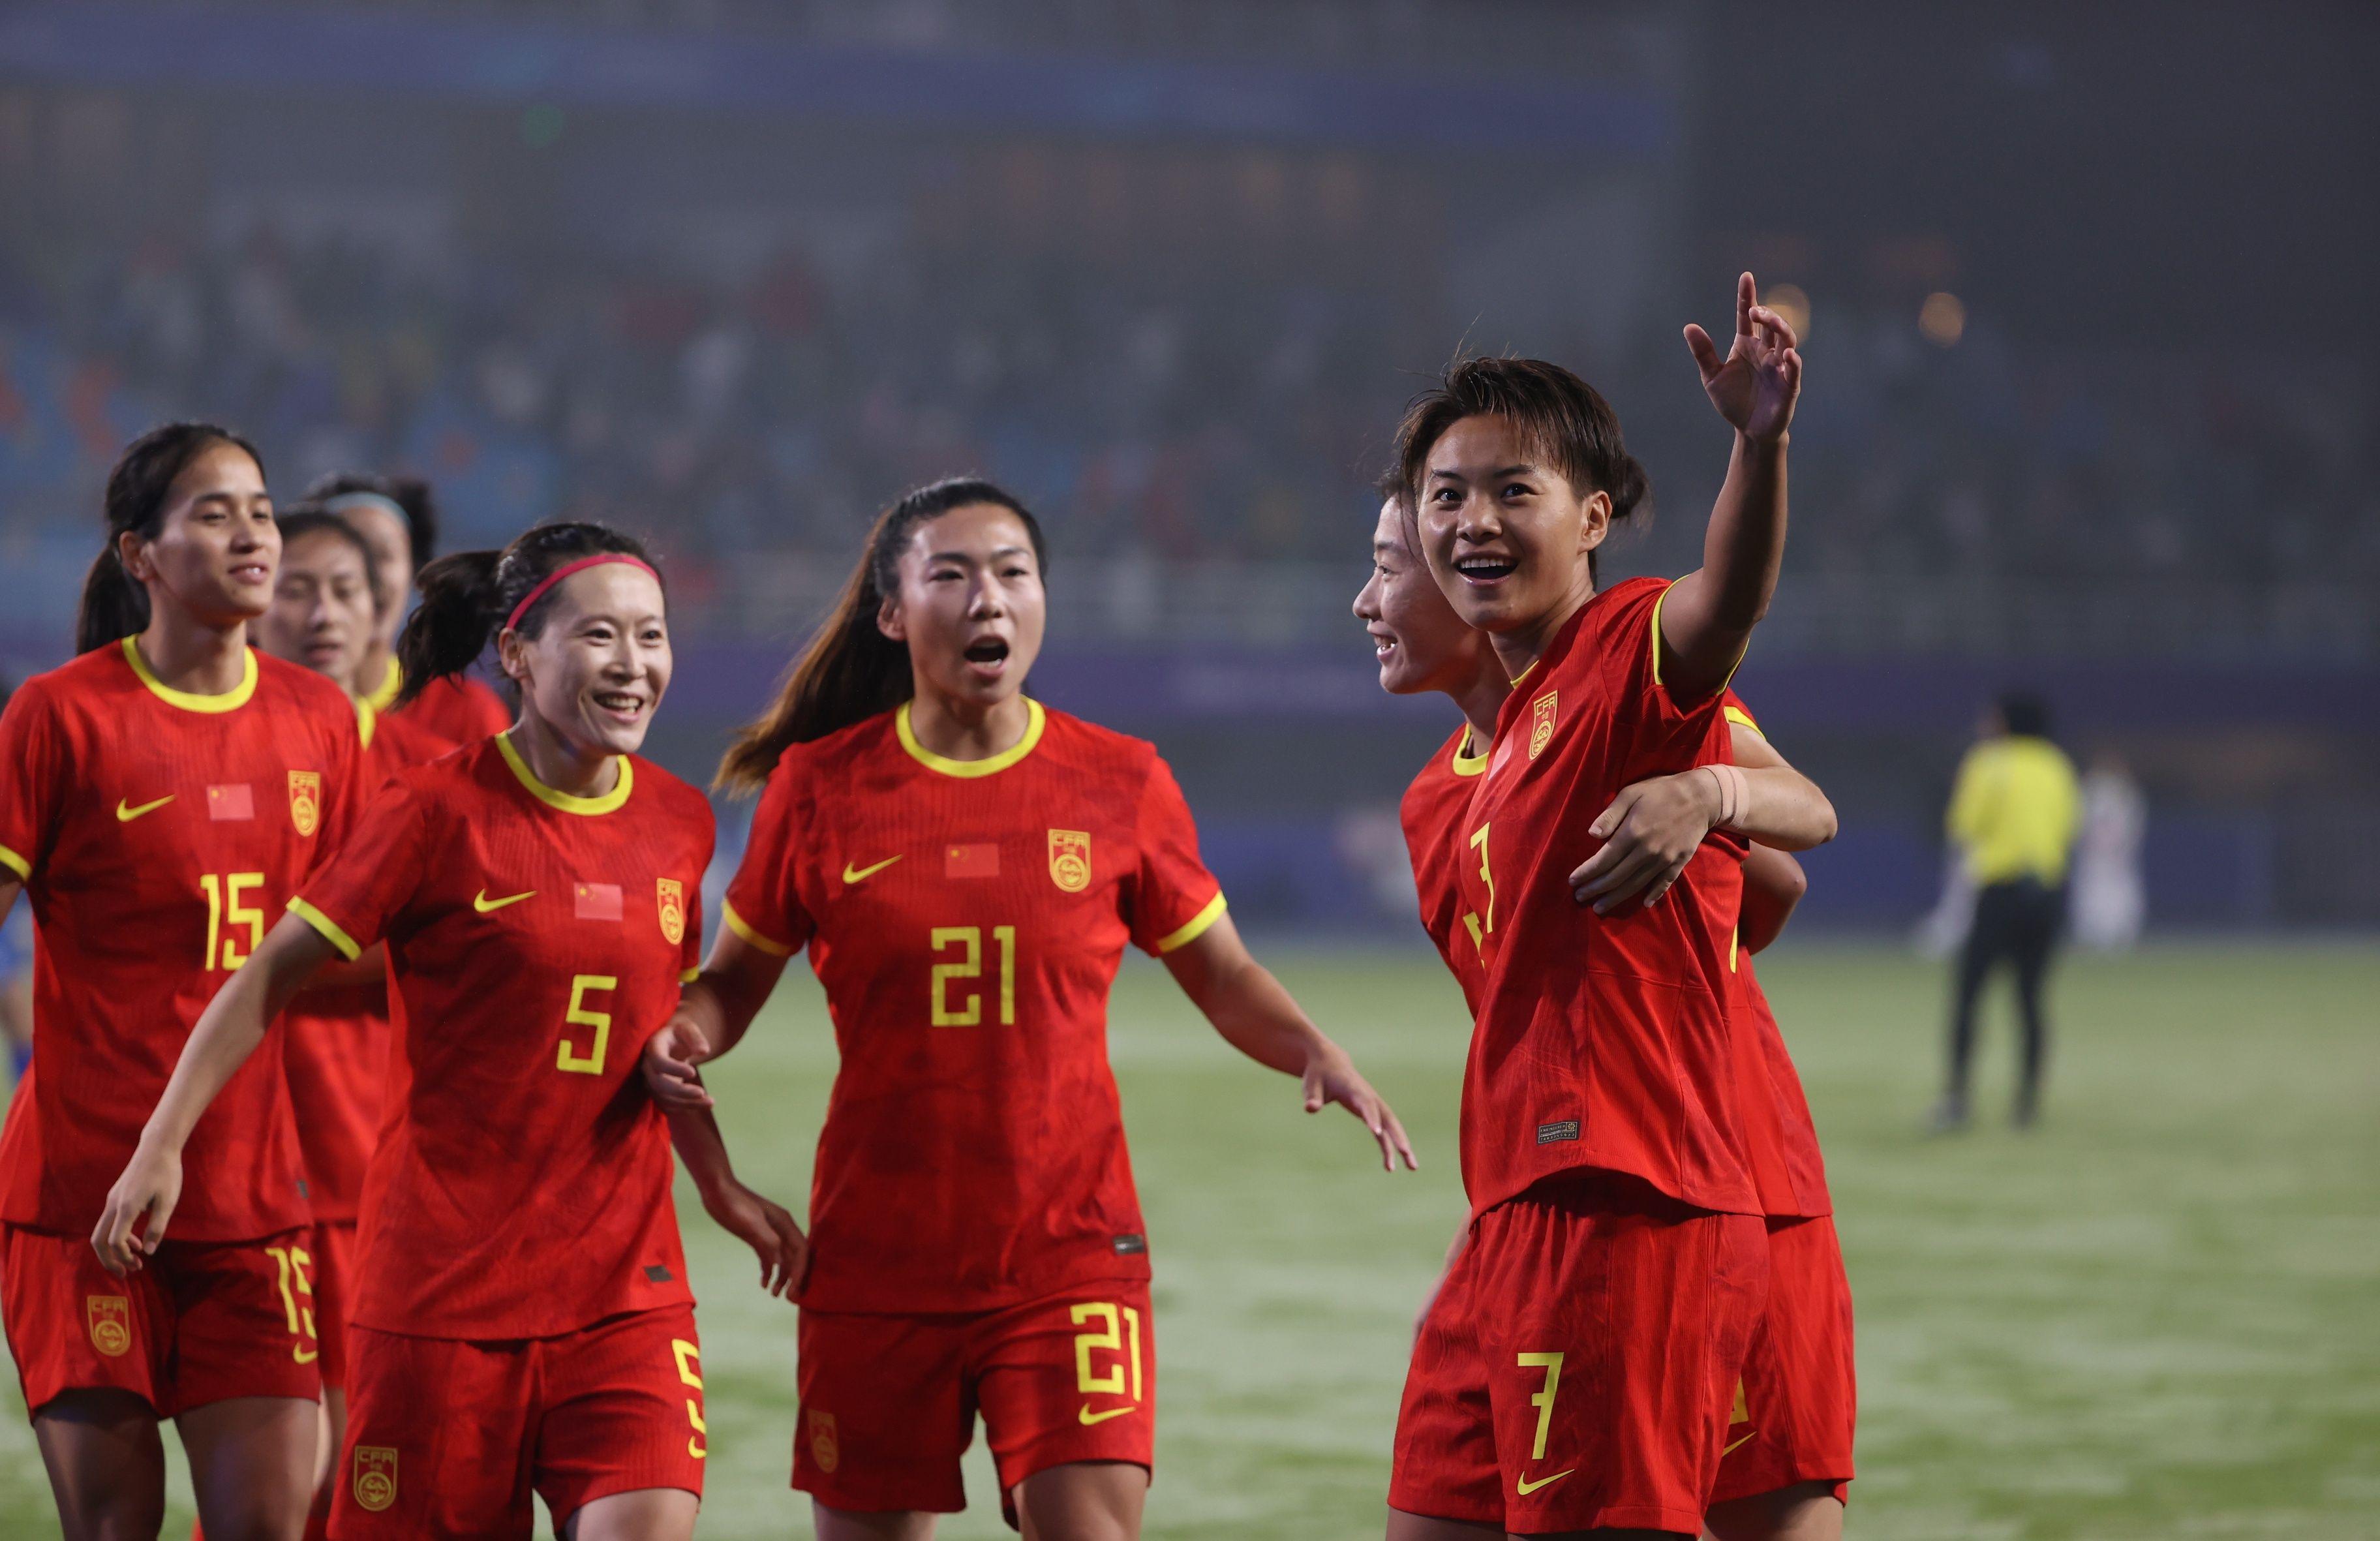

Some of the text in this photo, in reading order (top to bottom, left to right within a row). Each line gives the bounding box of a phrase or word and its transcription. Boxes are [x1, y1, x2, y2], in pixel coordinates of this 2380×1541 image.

[1536, 695, 1555, 716] CFA
[200, 872, 265, 971] 15
[1470, 821, 1494, 934] 7
[557, 974, 618, 1075] 5
[931, 926, 1015, 1026] 21
[1070, 1302, 1142, 1403] 21
[1518, 1352, 1564, 1459] 7
